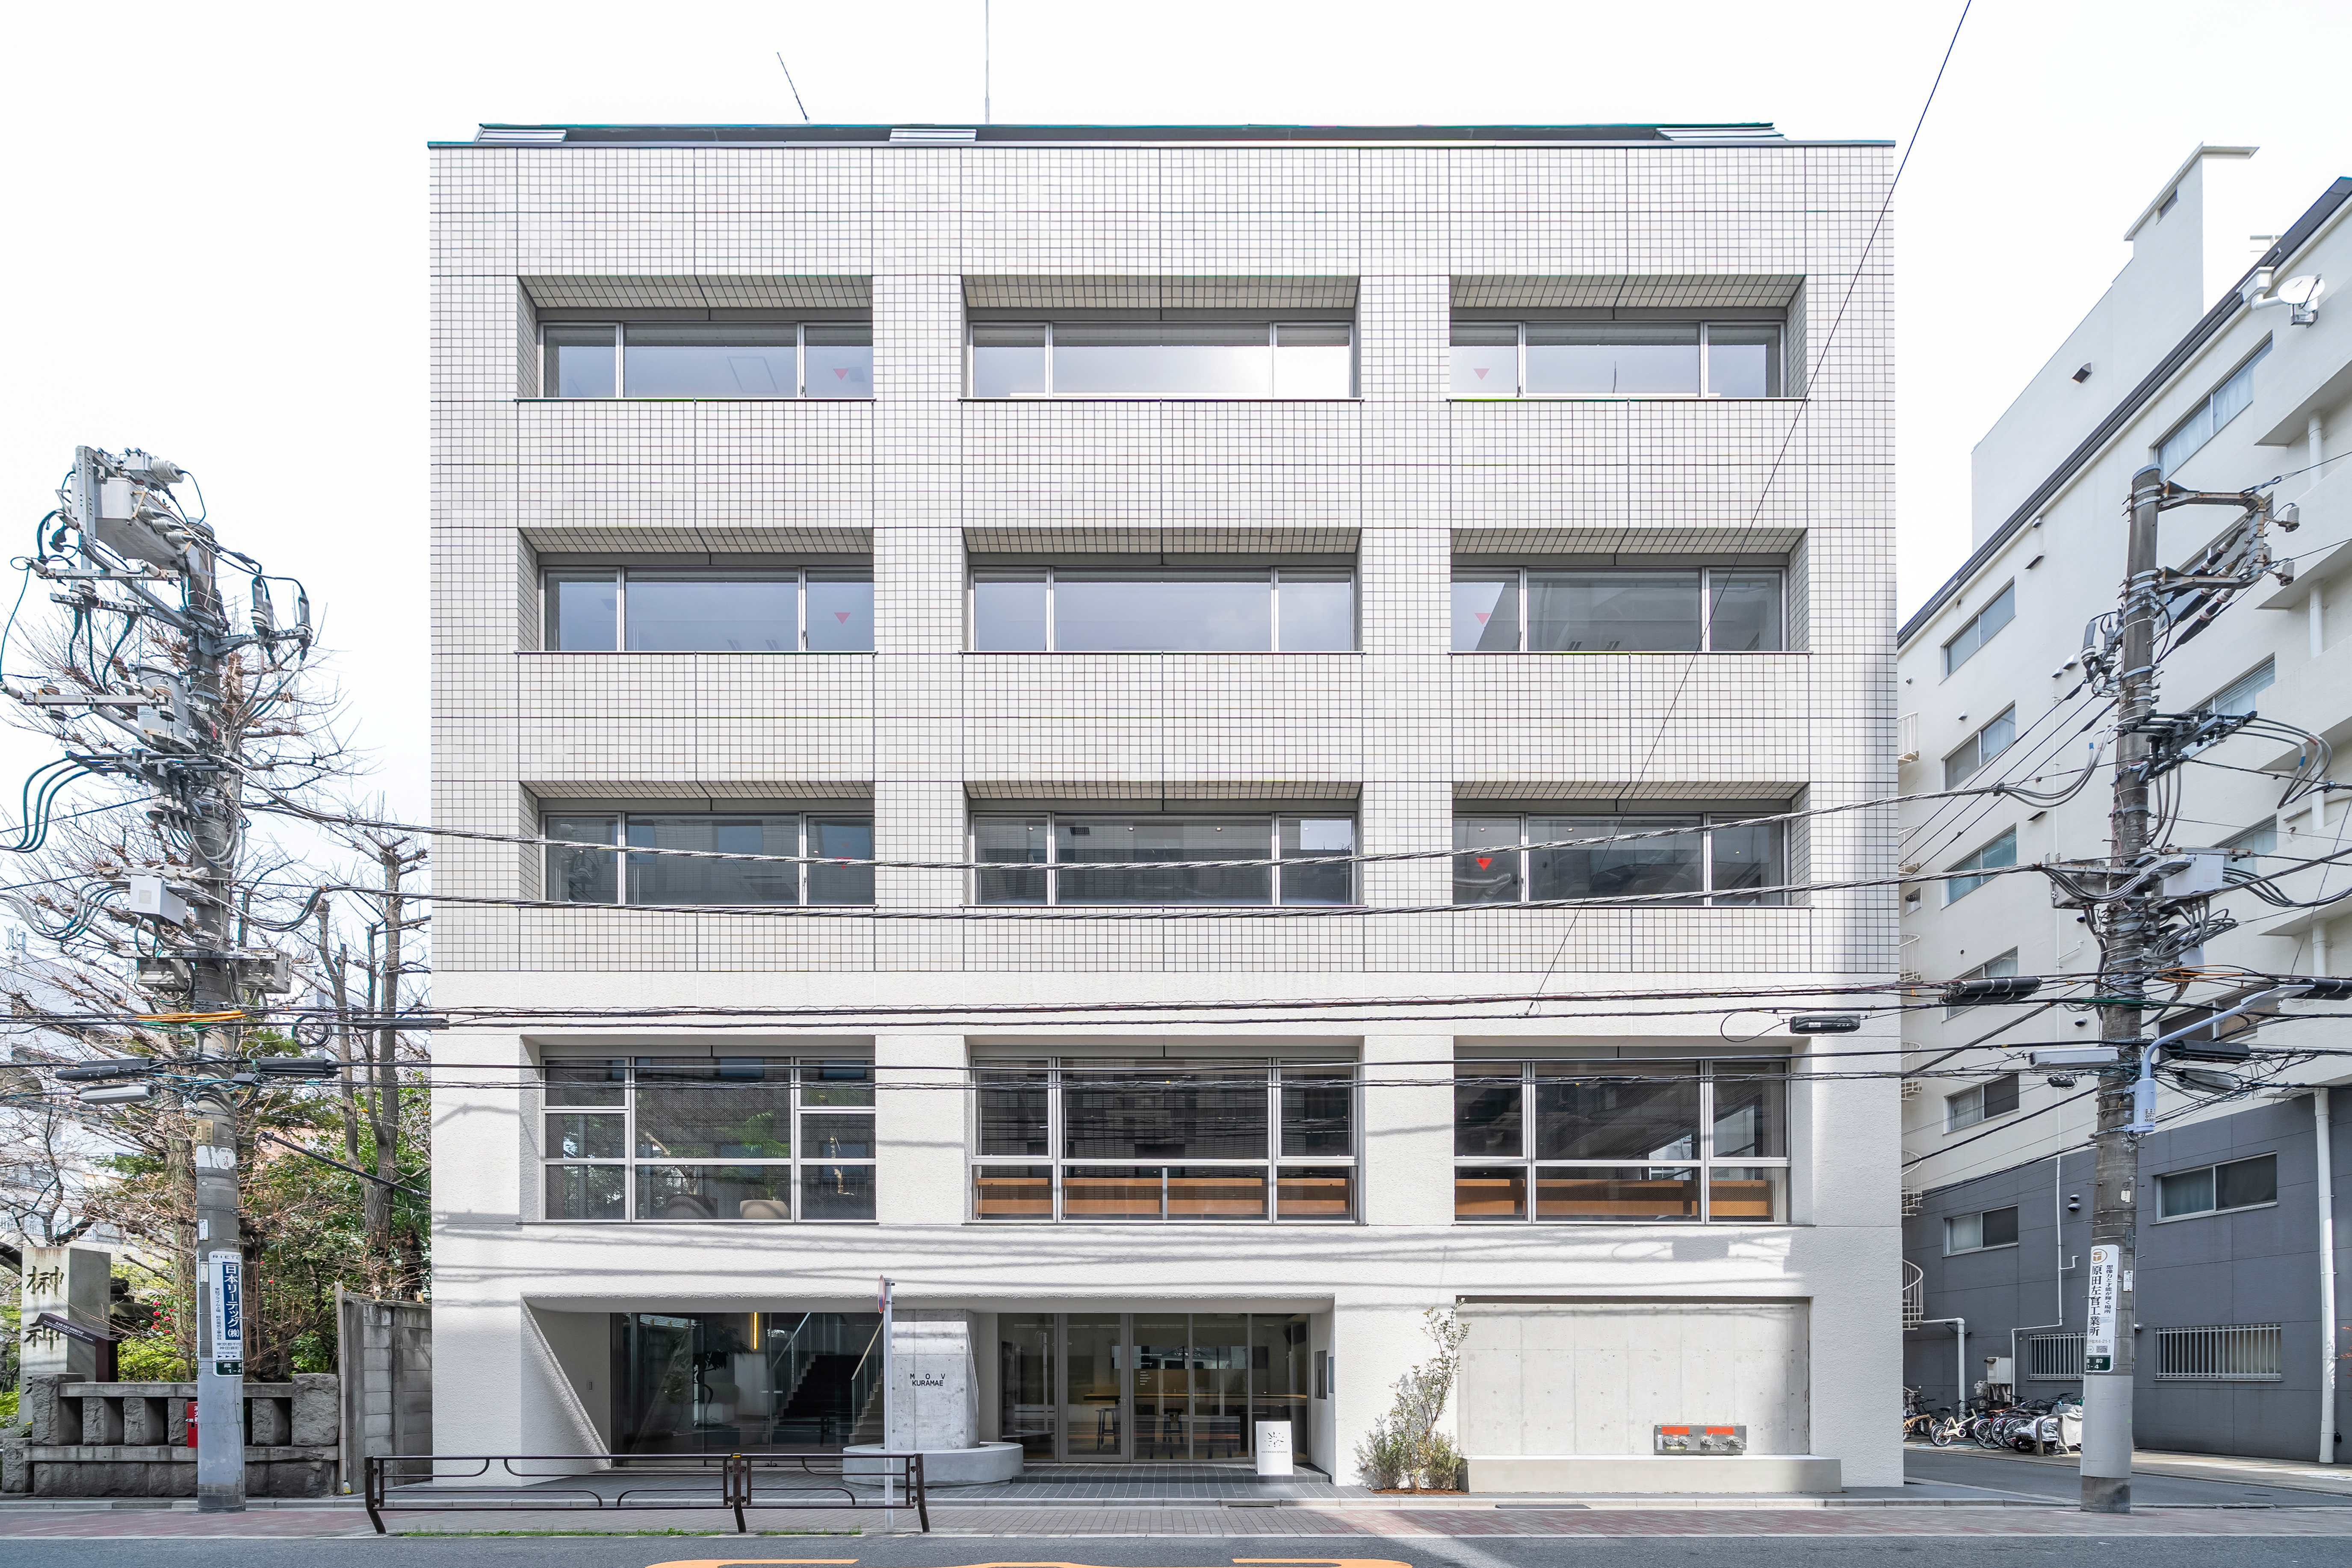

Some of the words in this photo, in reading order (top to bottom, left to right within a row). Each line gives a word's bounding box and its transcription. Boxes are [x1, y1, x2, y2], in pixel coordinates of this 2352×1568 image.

[2089, 1265, 2102, 1336] 原田左官工業所
[55, 1321, 69, 1330] SAKAKI
